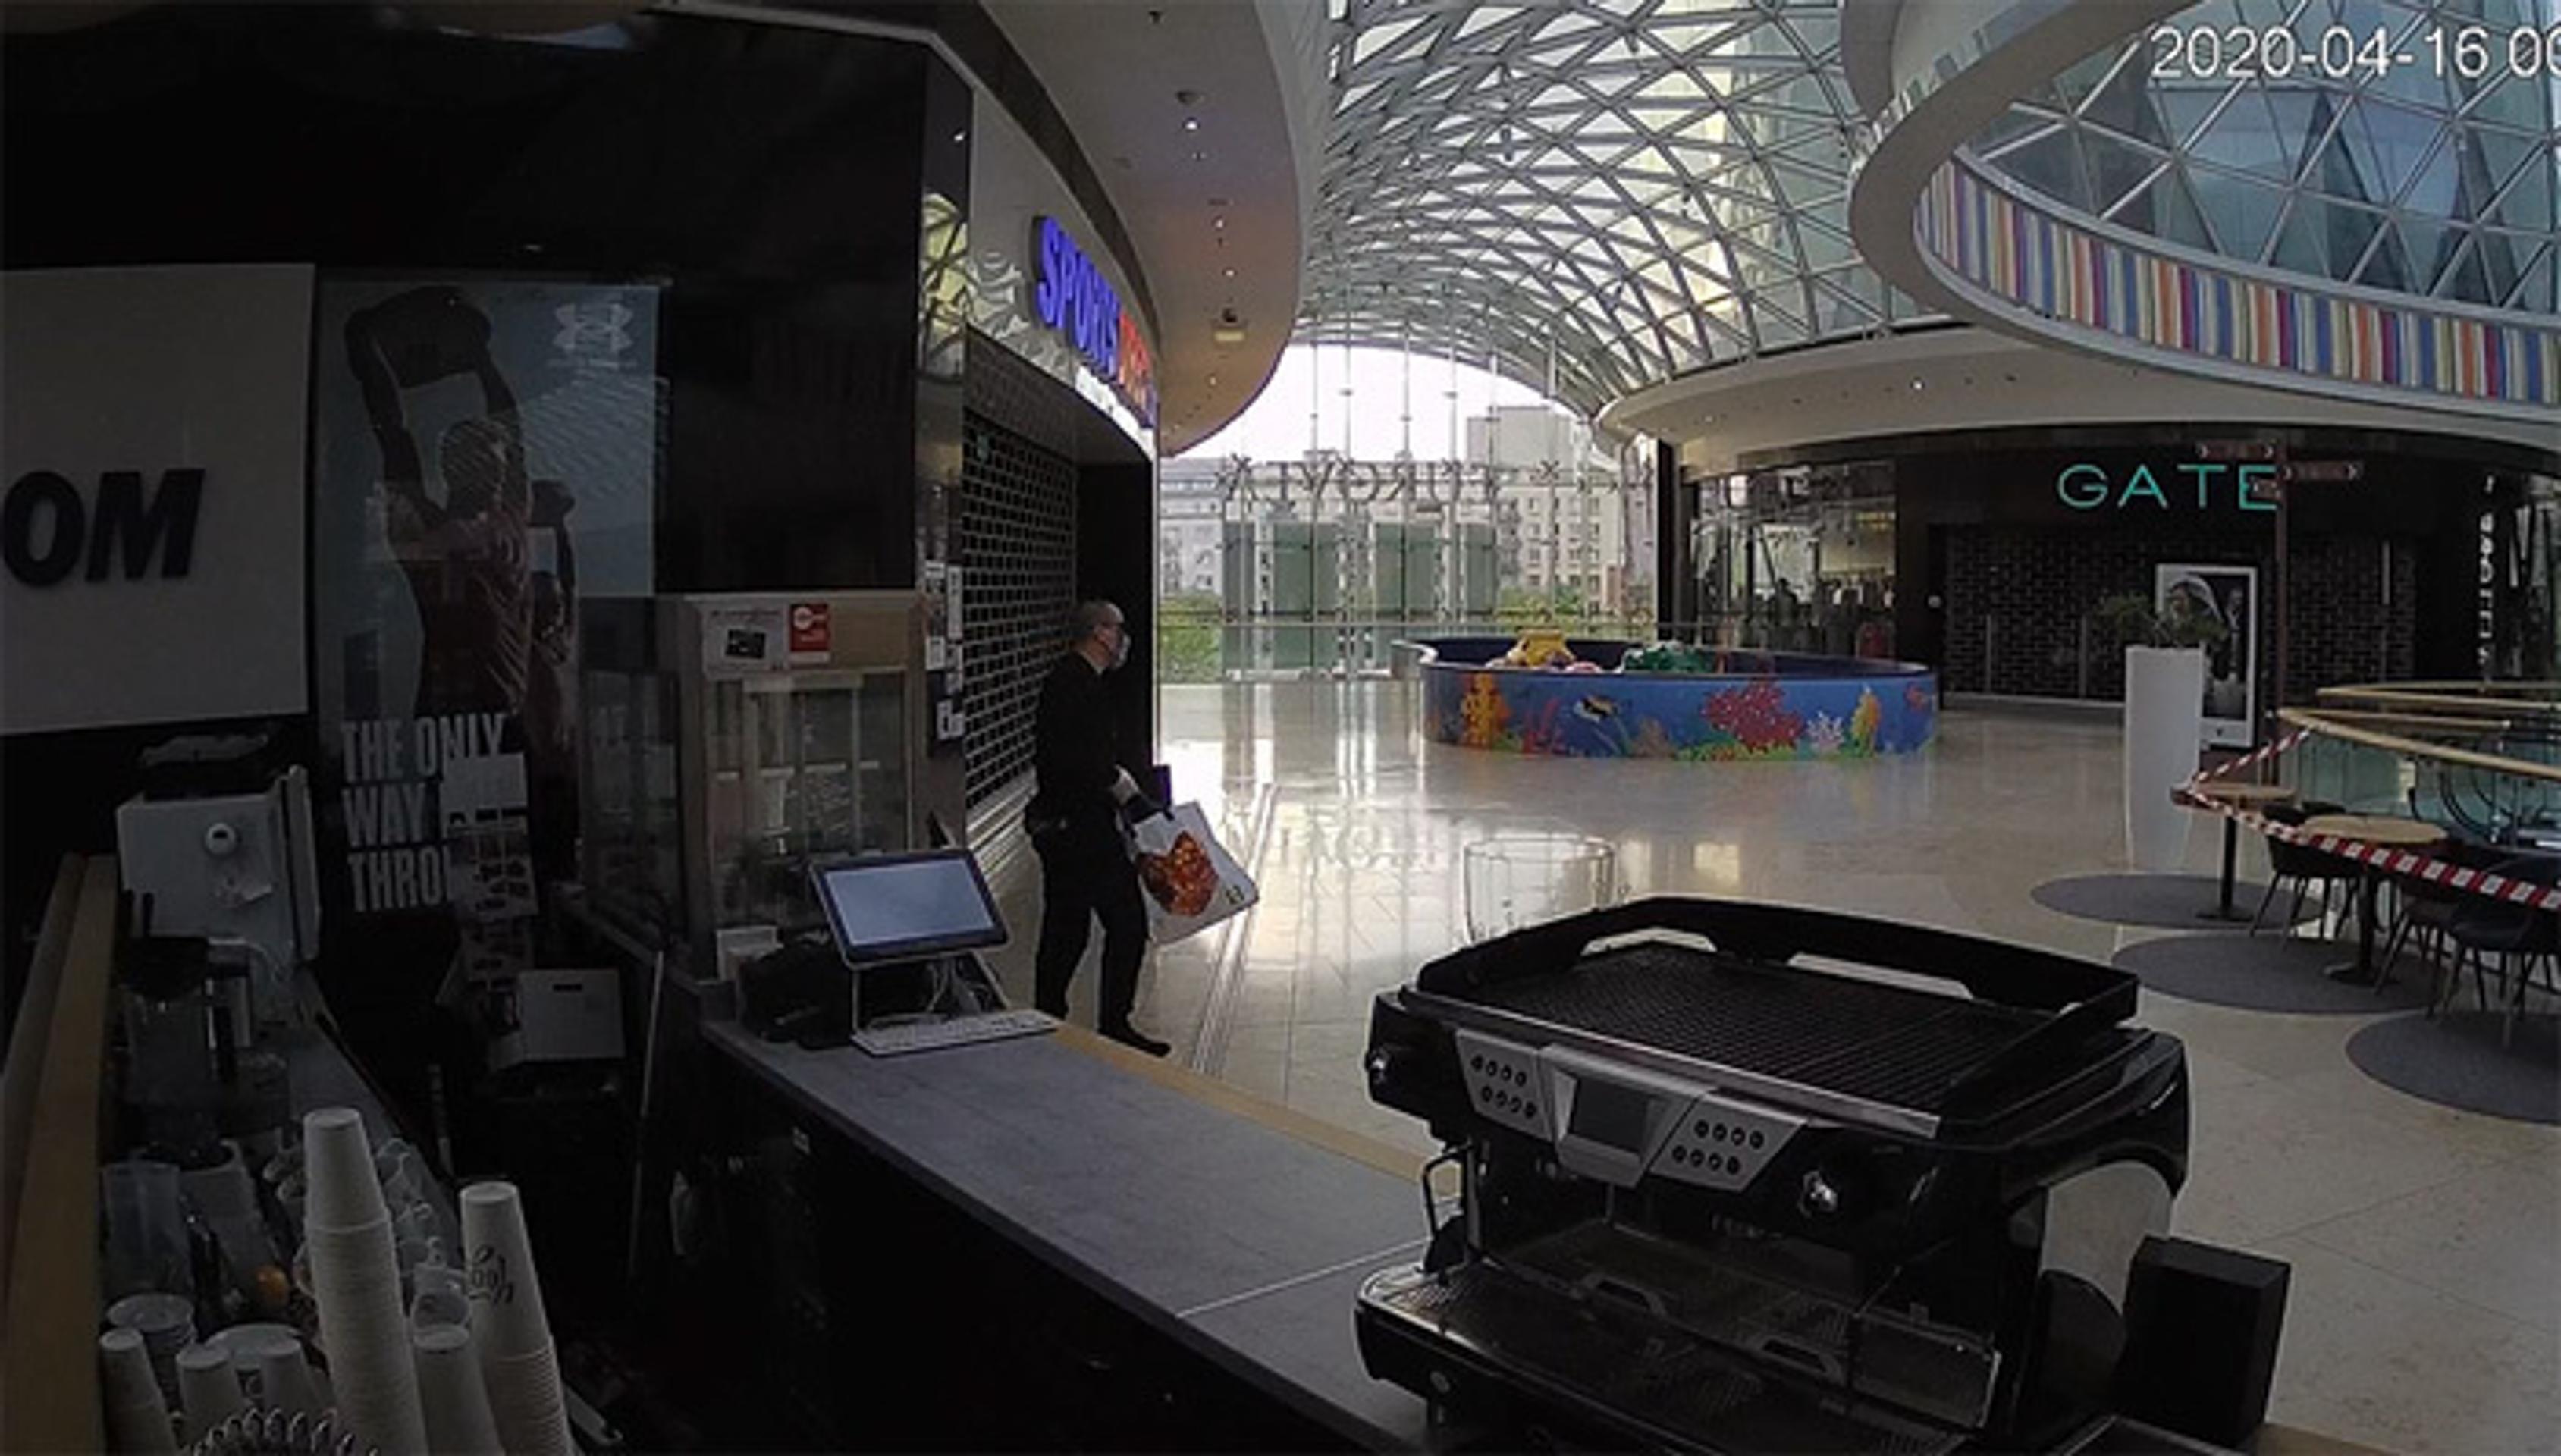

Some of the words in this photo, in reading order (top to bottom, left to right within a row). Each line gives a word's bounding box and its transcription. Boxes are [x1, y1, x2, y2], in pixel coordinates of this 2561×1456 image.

[2056, 463, 2280, 512] GATE
[341, 720, 404, 784] THE
[341, 782, 428, 849] WAY
